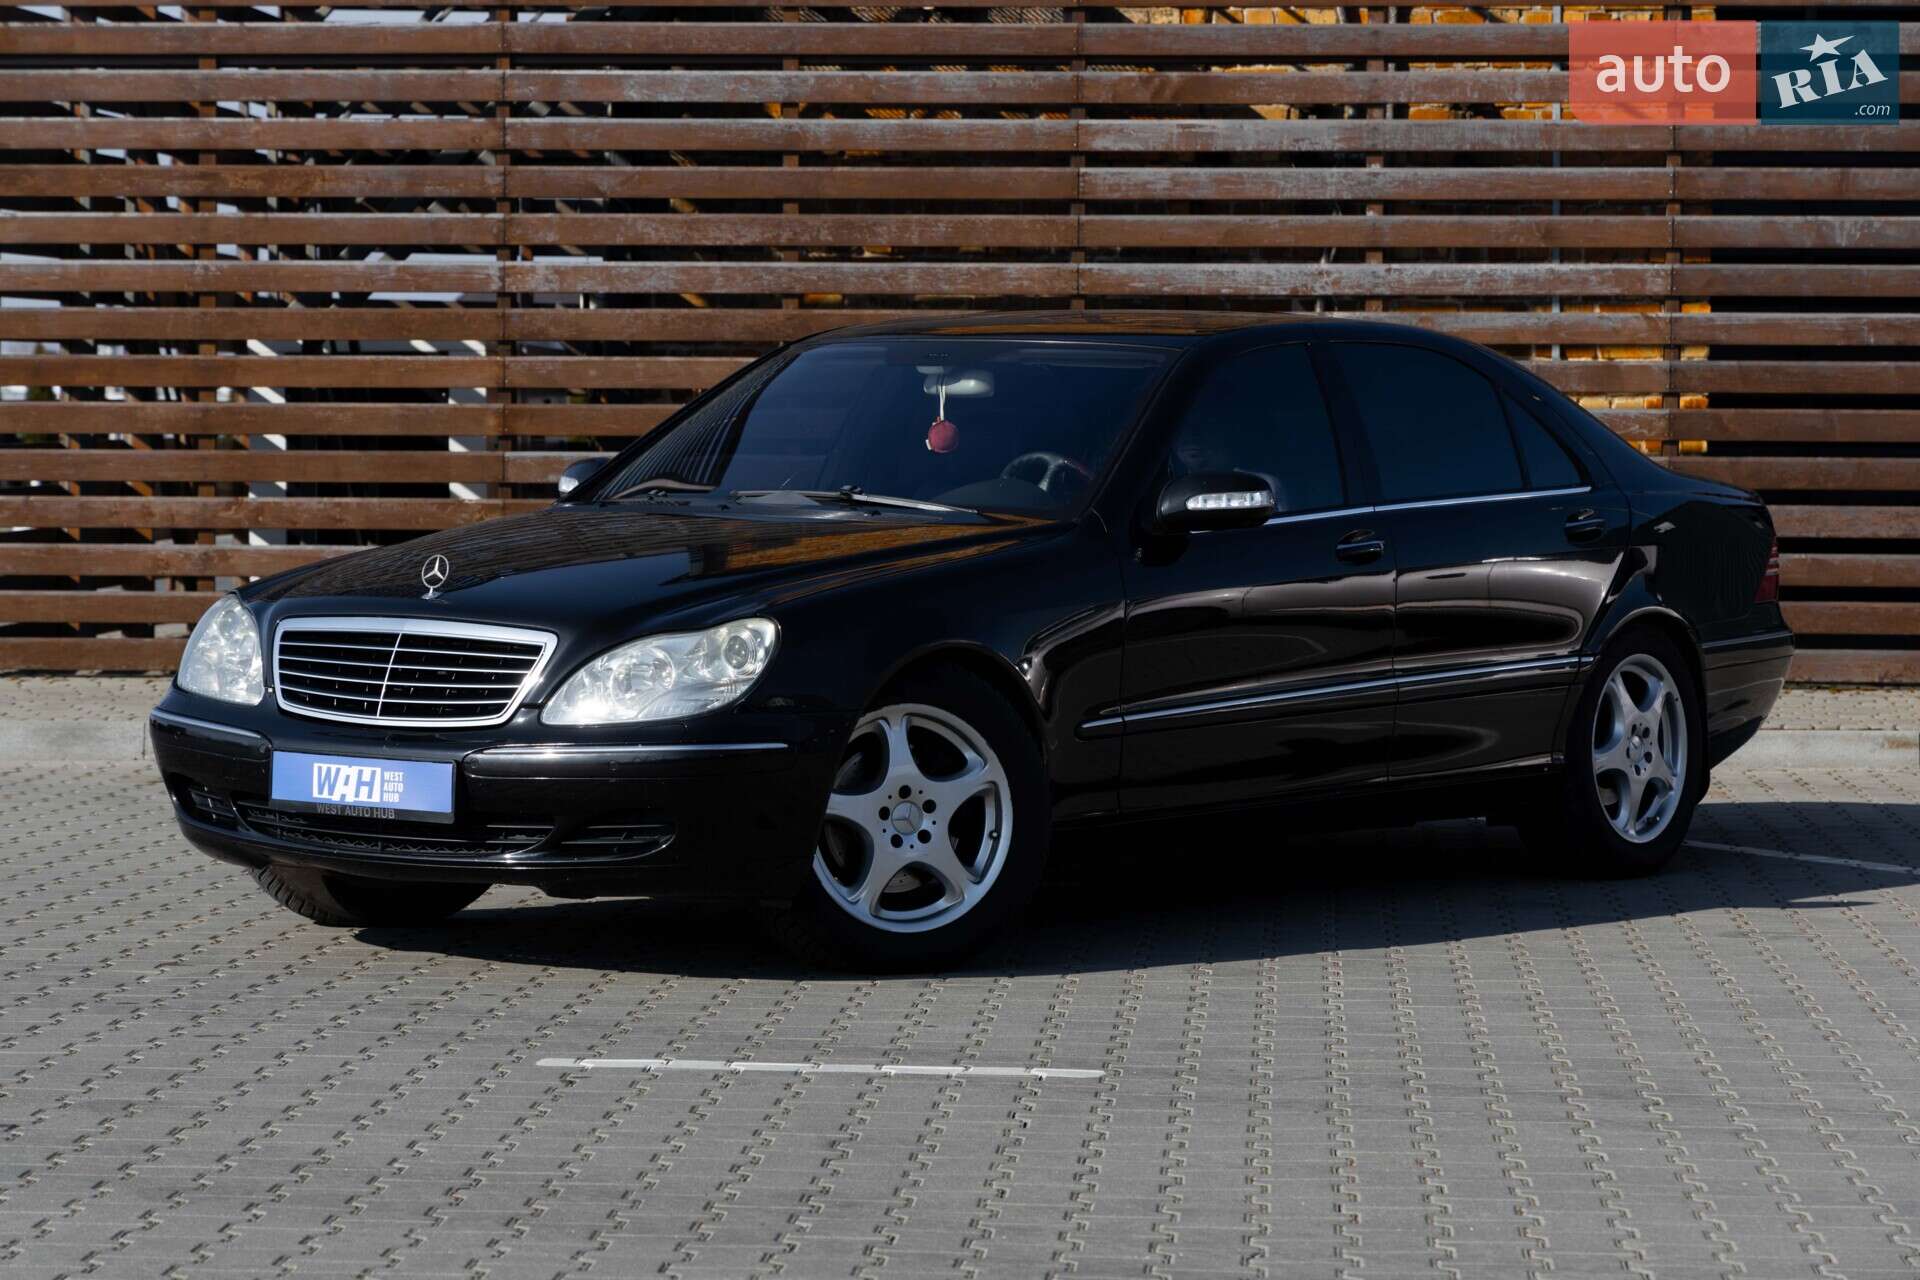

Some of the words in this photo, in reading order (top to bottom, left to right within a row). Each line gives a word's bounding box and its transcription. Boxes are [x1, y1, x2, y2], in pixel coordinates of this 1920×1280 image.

[383, 771, 404, 782] WEST
[383, 782, 404, 792] AUTO
[316, 804, 342, 815] WEST
[345, 805, 370, 818] AUTO
[373, 808, 396, 819] HUB
